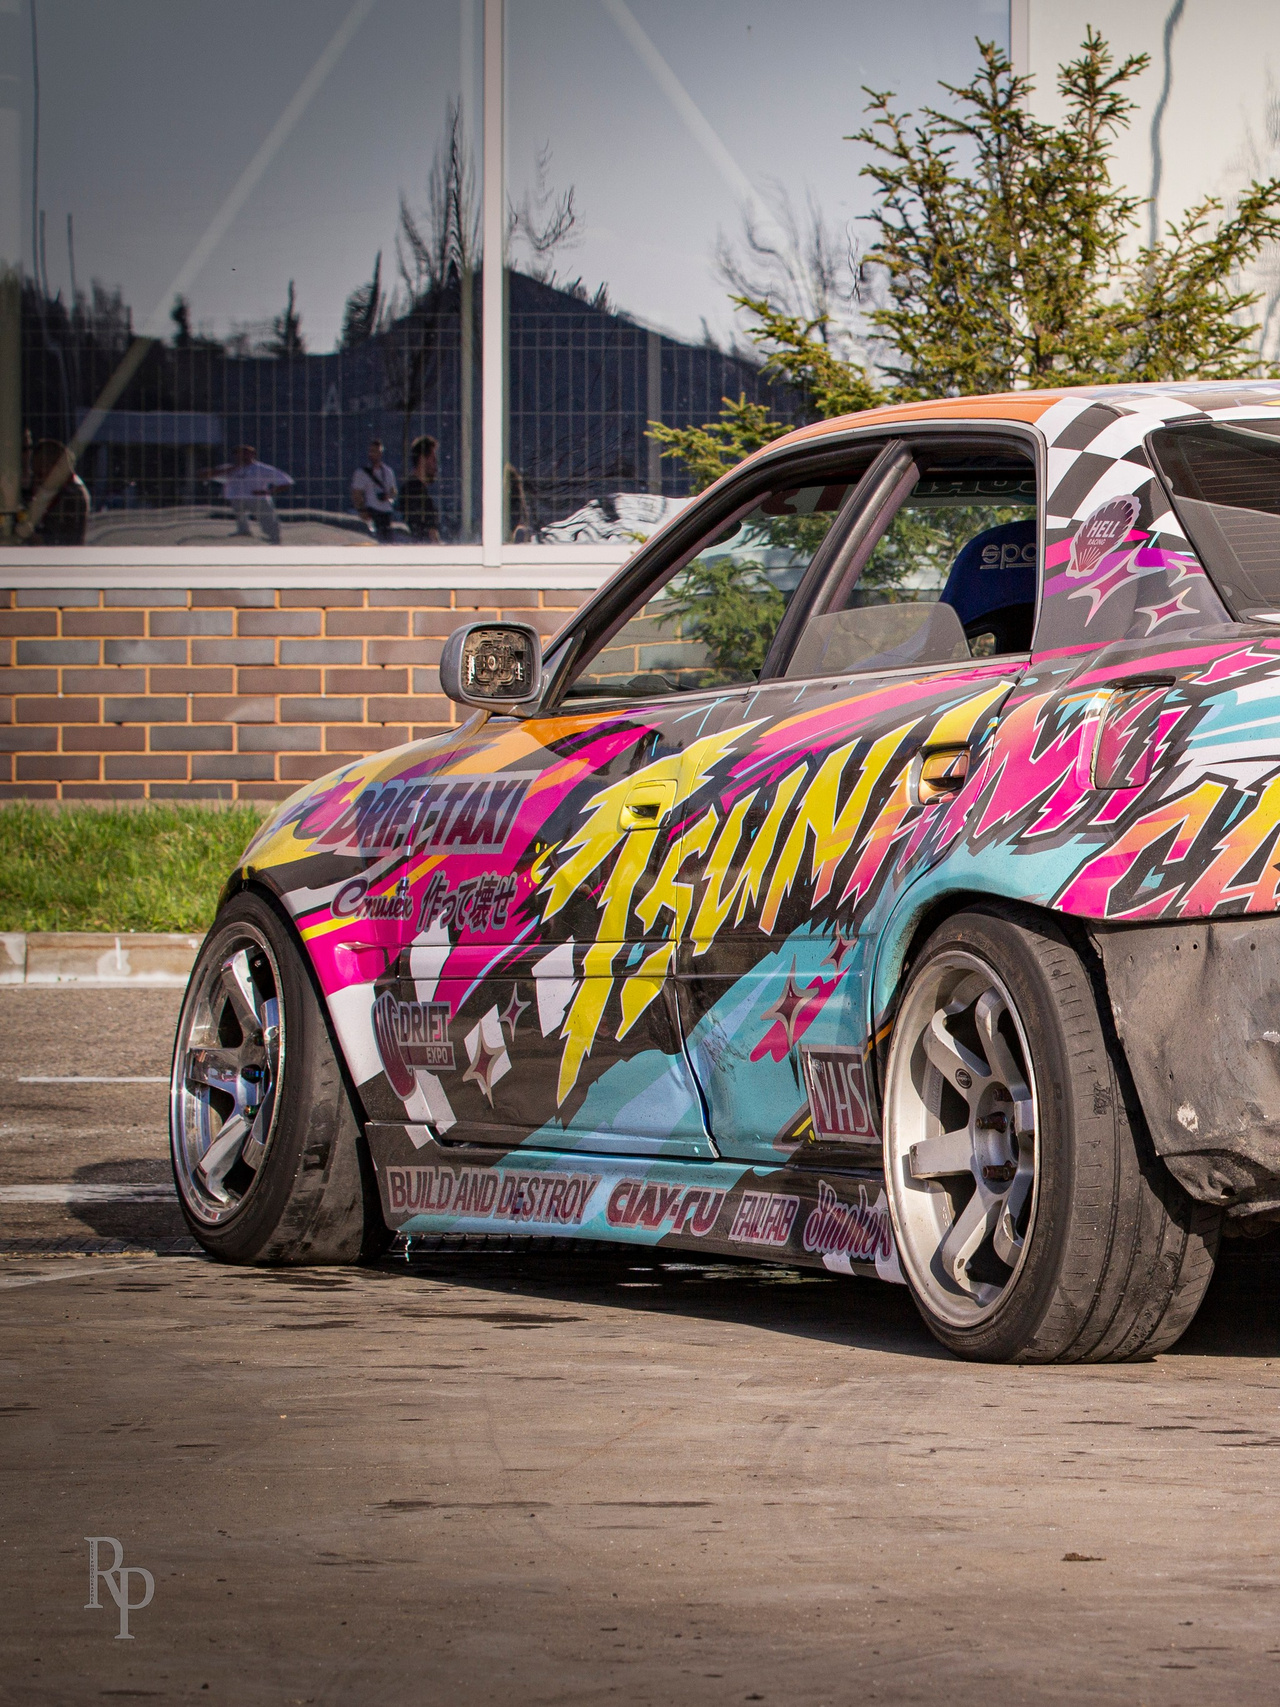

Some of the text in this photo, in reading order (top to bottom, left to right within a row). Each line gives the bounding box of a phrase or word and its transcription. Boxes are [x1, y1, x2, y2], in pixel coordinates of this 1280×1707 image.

[1086, 520, 1121, 538] HELL
[1087, 538, 1107, 546] RACING
[316, 778, 533, 849] DRIFT TAXI
[419, 872, 517, 931] 作って壊せ
[399, 1005, 451, 1042] DRIFT
[426, 1046, 448, 1064] EXPO
[389, 1170, 600, 1221] BUILD AND DESTROY
